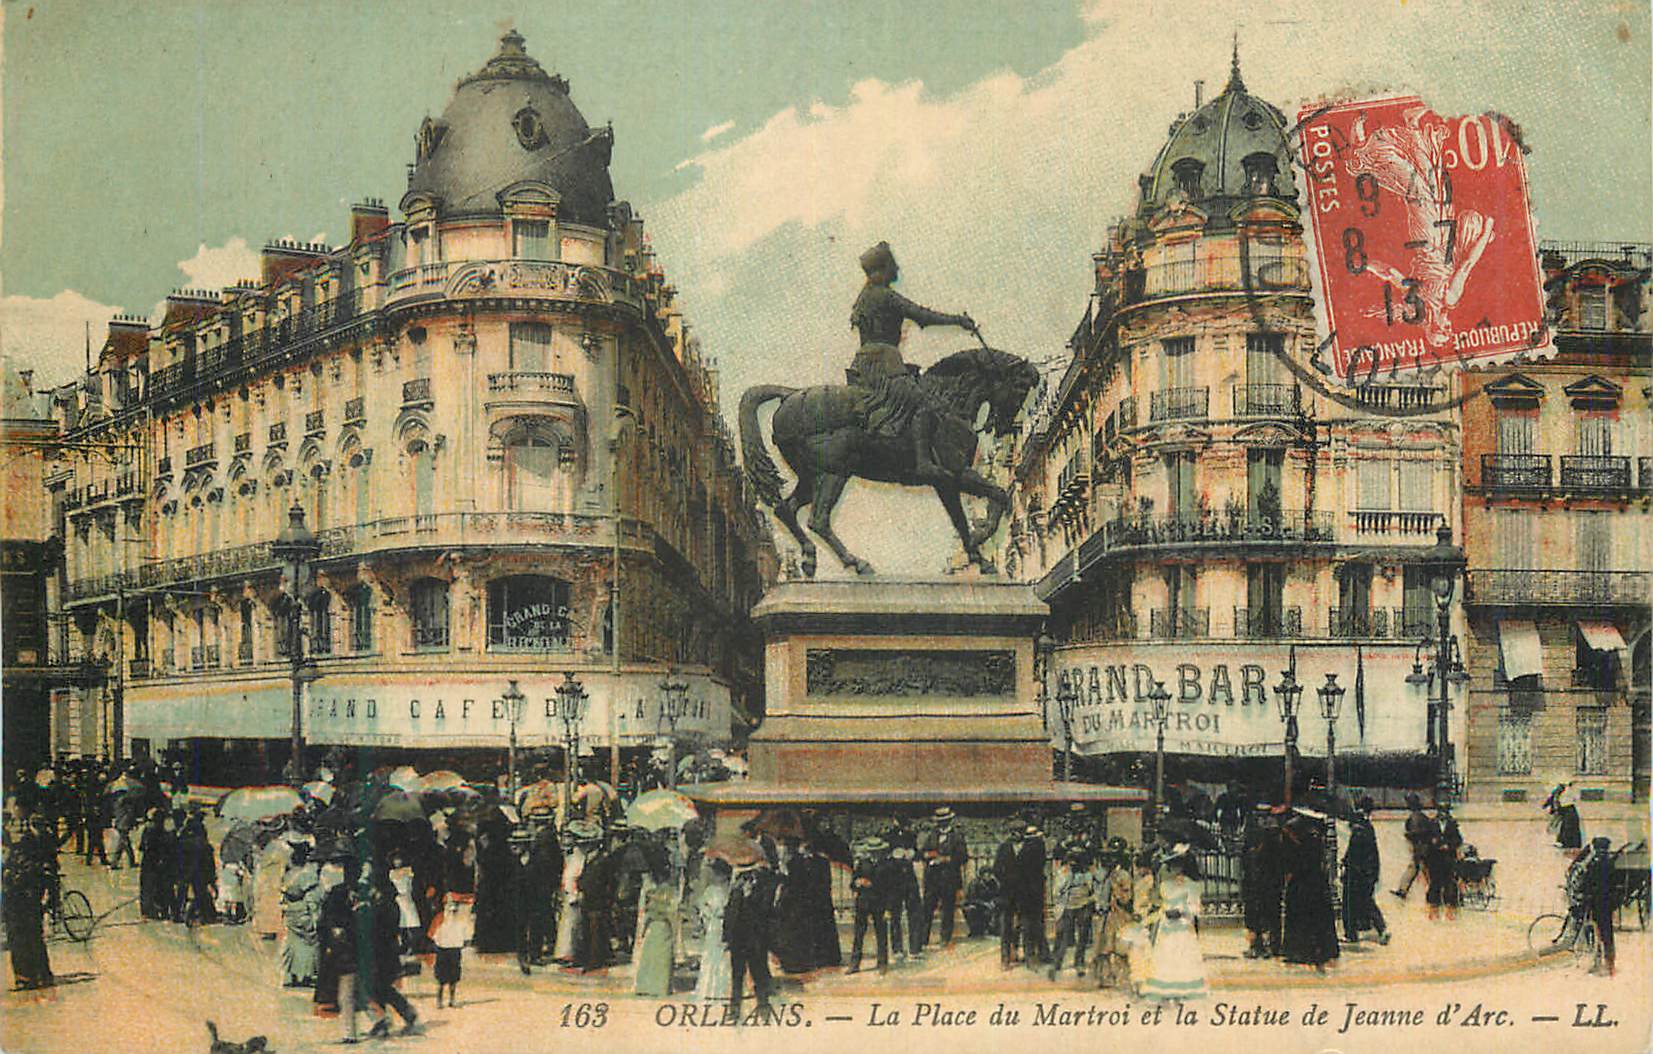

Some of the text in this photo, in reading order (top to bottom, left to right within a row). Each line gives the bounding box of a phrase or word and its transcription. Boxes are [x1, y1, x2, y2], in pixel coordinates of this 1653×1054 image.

[1310, 125, 1340, 213] POSTES
[1342, 226, 1368, 276] 8
[1383, 277, 1427, 327] 13
[505, 603, 550, 628] GRAND
[1176, 663, 1267, 706] BAR
[409, 698, 505, 719] CAFE
[1082, 708, 1221, 734] DU MARTROI
